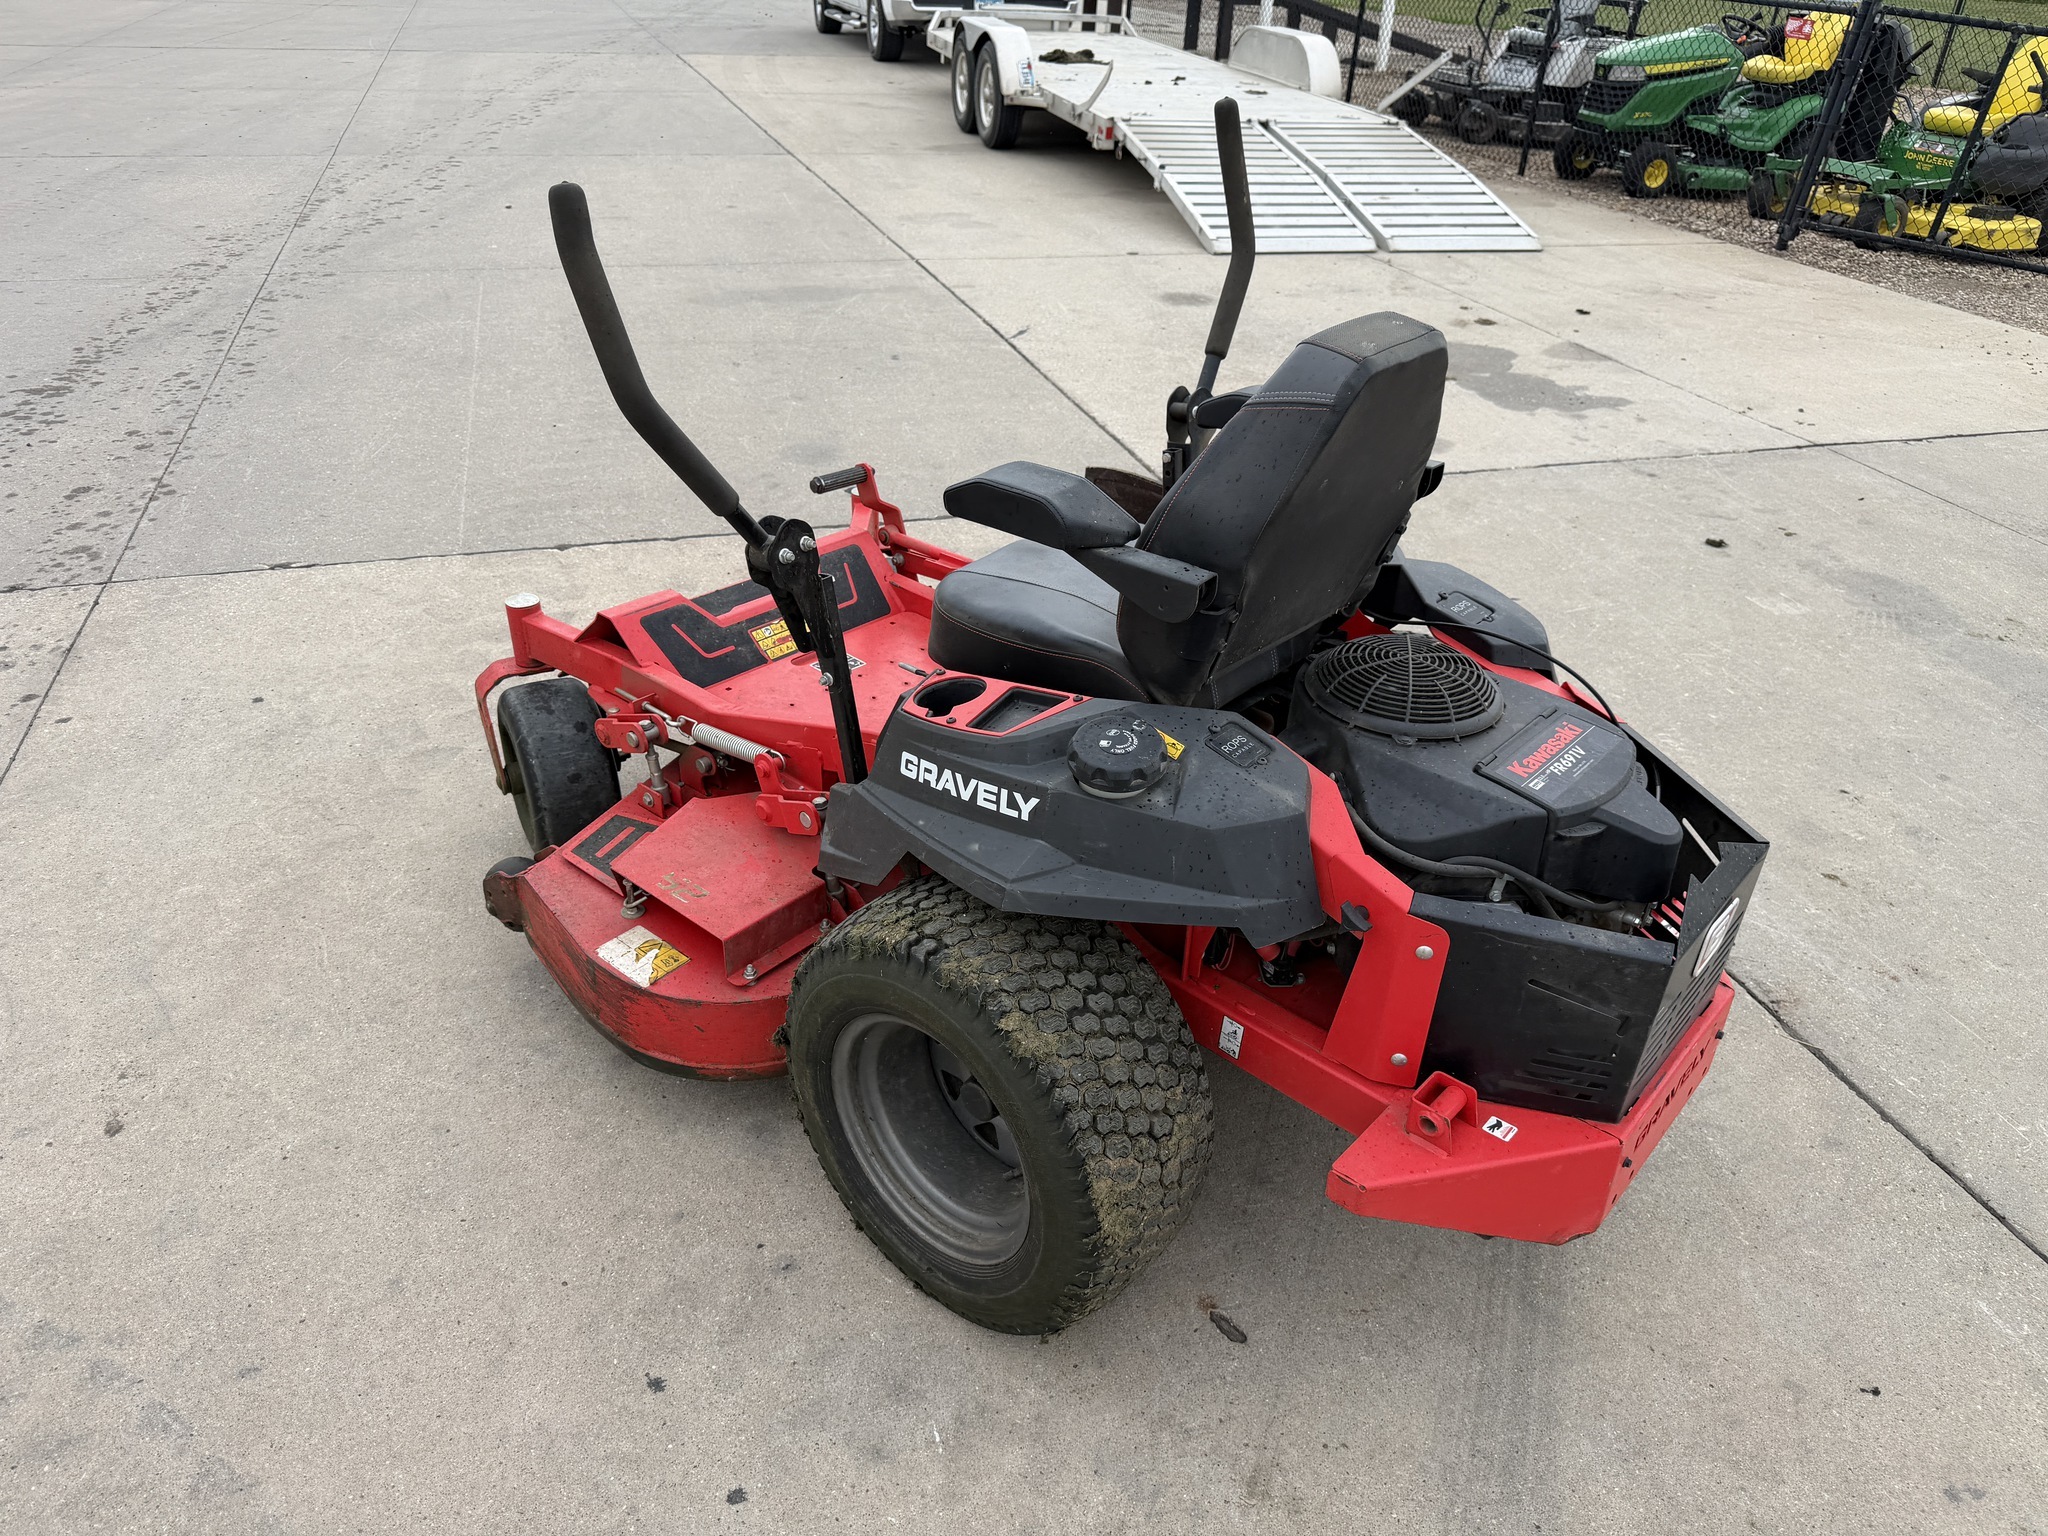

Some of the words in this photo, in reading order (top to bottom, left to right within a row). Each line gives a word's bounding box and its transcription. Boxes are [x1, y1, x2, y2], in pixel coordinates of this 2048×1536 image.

[1904, 150, 1925, 162] JOHN
[1926, 154, 1955, 168] DEERE
[1451, 600, 1471, 613] ROPS
[1221, 735, 1247, 753] ROPS
[1232, 742, 1255, 758] CAPABLE
[1506, 721, 1583, 778] Kawasaki
[1549, 745, 1586, 776] FR691V
[900, 751, 1040, 821] GRAVELY
[1634, 1037, 1712, 1152] GRAVELY
